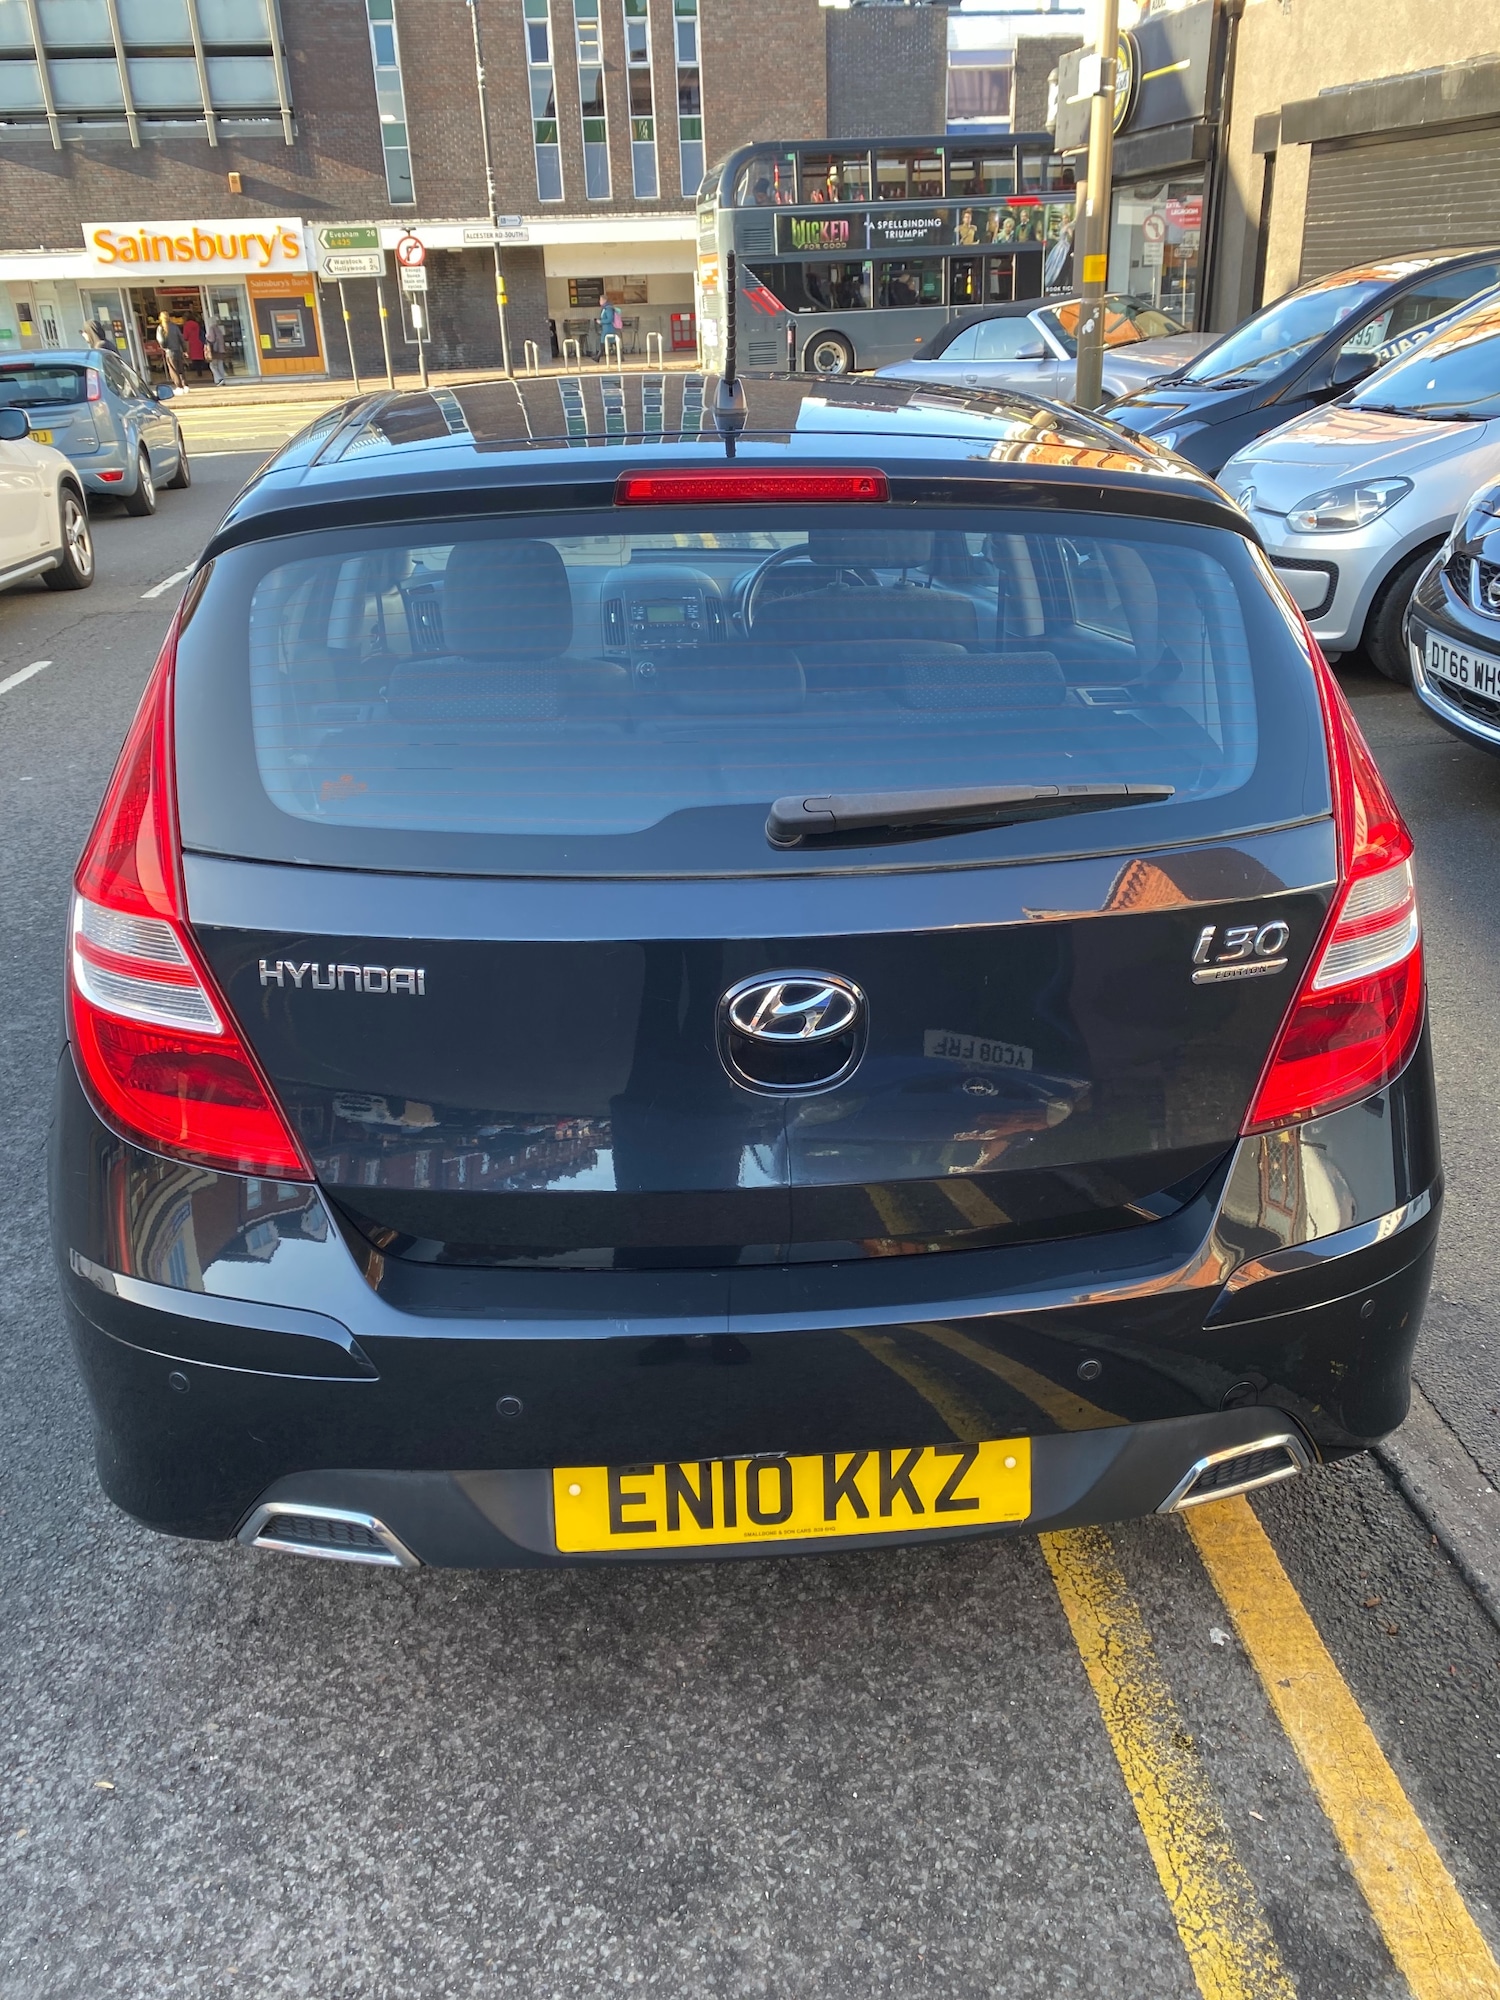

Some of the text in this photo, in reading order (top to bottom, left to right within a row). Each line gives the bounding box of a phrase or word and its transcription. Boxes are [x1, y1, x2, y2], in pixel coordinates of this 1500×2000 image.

[366, 229, 376, 237] 26
[466, 232, 494, 240] ALCESTER
[791, 217, 849, 247] WICKED
[877, 218, 942, 230] SPELLBINDING
[93, 226, 300, 267] Sainsbury's
[1432, 642, 1469, 683] DT66
[258, 959, 426, 996] HYUNDAI
[1215, 964, 1267, 979] EDITION
[823, 1443, 980, 1522] KKZ
